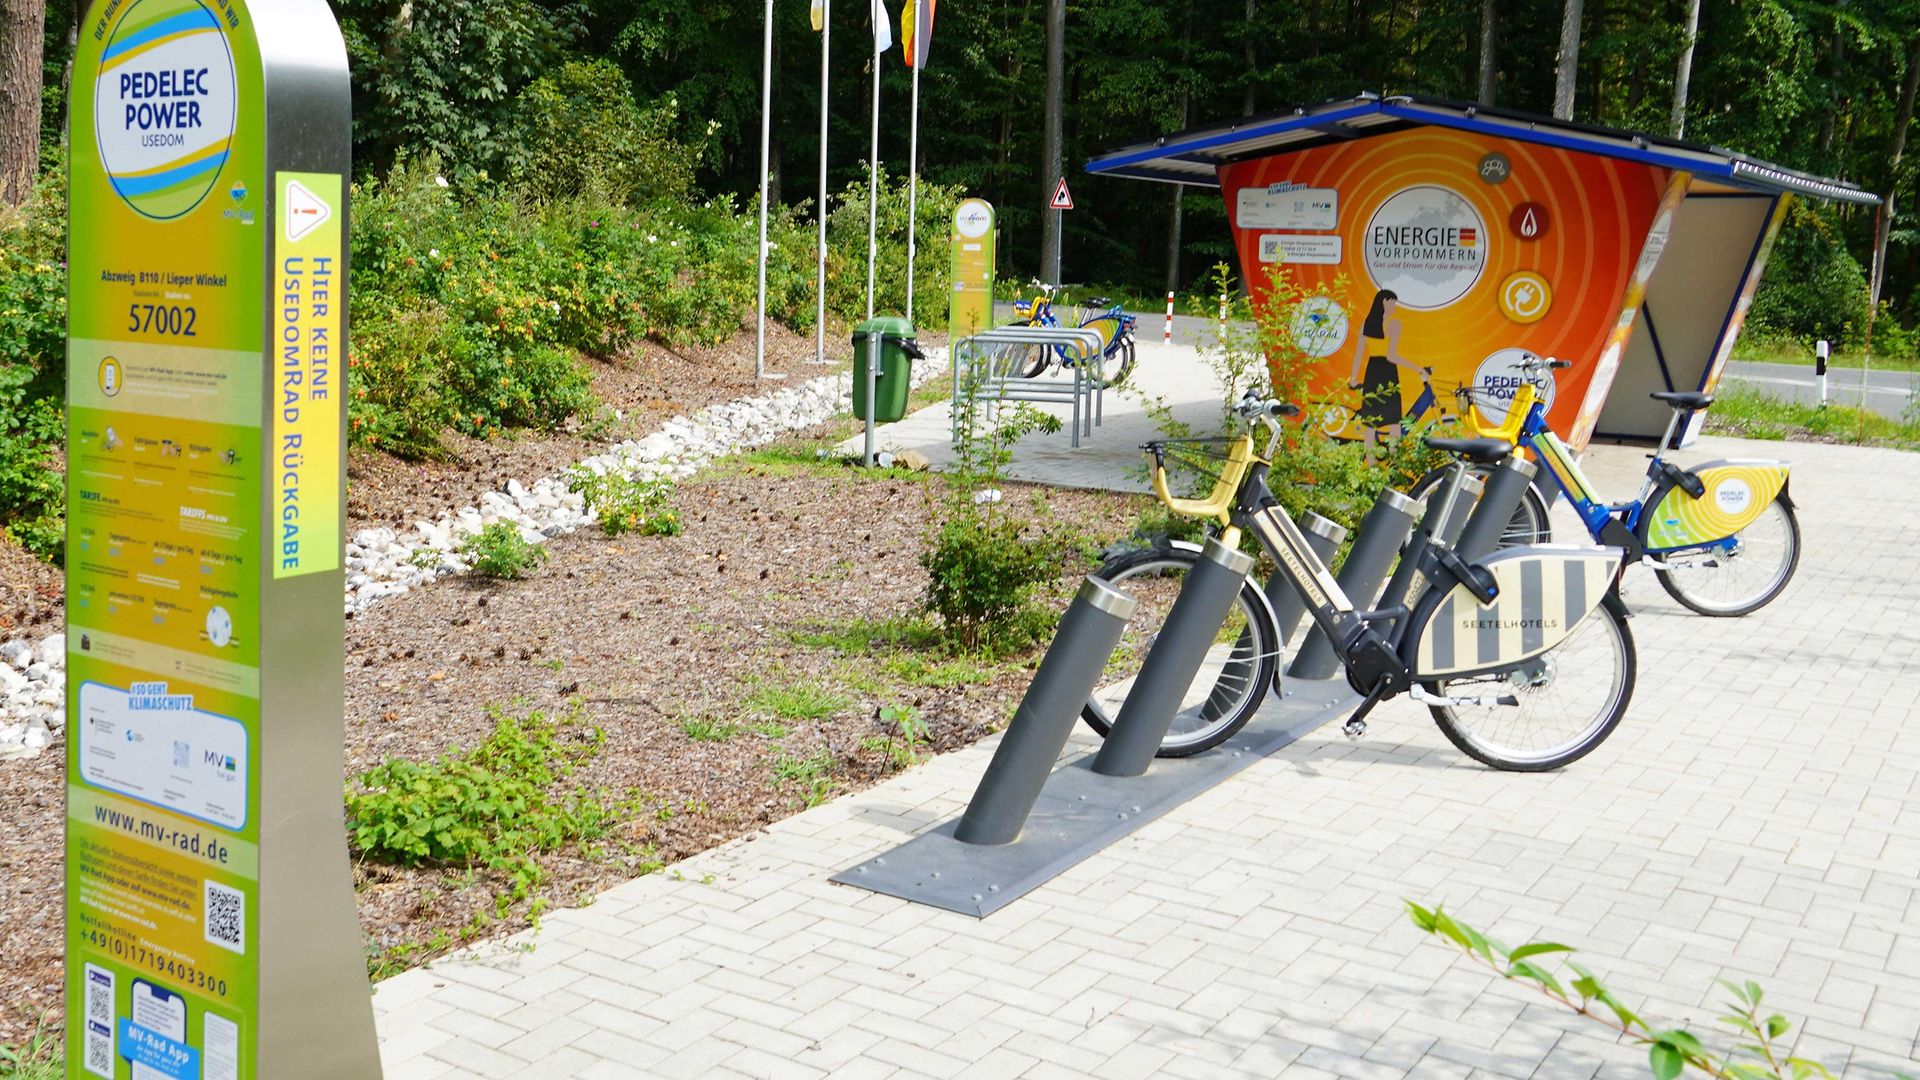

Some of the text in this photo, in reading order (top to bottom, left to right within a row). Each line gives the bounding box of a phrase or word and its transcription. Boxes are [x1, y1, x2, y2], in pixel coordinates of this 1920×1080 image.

[94, 0, 121, 40] DER BUN
[225, 5, 239, 30] WIR
[120, 68, 208, 99] PEDELEC
[125, 101, 202, 130] POWER
[142, 134, 184, 147] USEDOM
[1374, 226, 1457, 247] ENERGIE
[1374, 247, 1476, 260] VORPOMMERN
[1424, 262, 1435, 270] für
[1437, 262, 1448, 270] die
[101, 270, 227, 288] Abzweig B110 / Lieper Winkel
[128, 304, 196, 336] 57002
[312, 257, 332, 400] HIER KEINE
[283, 434, 304, 569] RÜCKGABE
[1281, 547, 1324, 603] SEETELHOTELS
[1462, 619, 1558, 629] SEETELHOTELS
[132, 684, 166, 695] #SO GEHT
[128, 697, 193, 711] KLIMASCHUTZ
[204, 750, 224, 767] MV
[95, 804, 228, 862] www.mv-rad.de
[80, 929, 227, 997] +49(0)1719403300
[127, 1025, 167, 1053] MV-Rad
[168, 1043, 190, 1064] App
